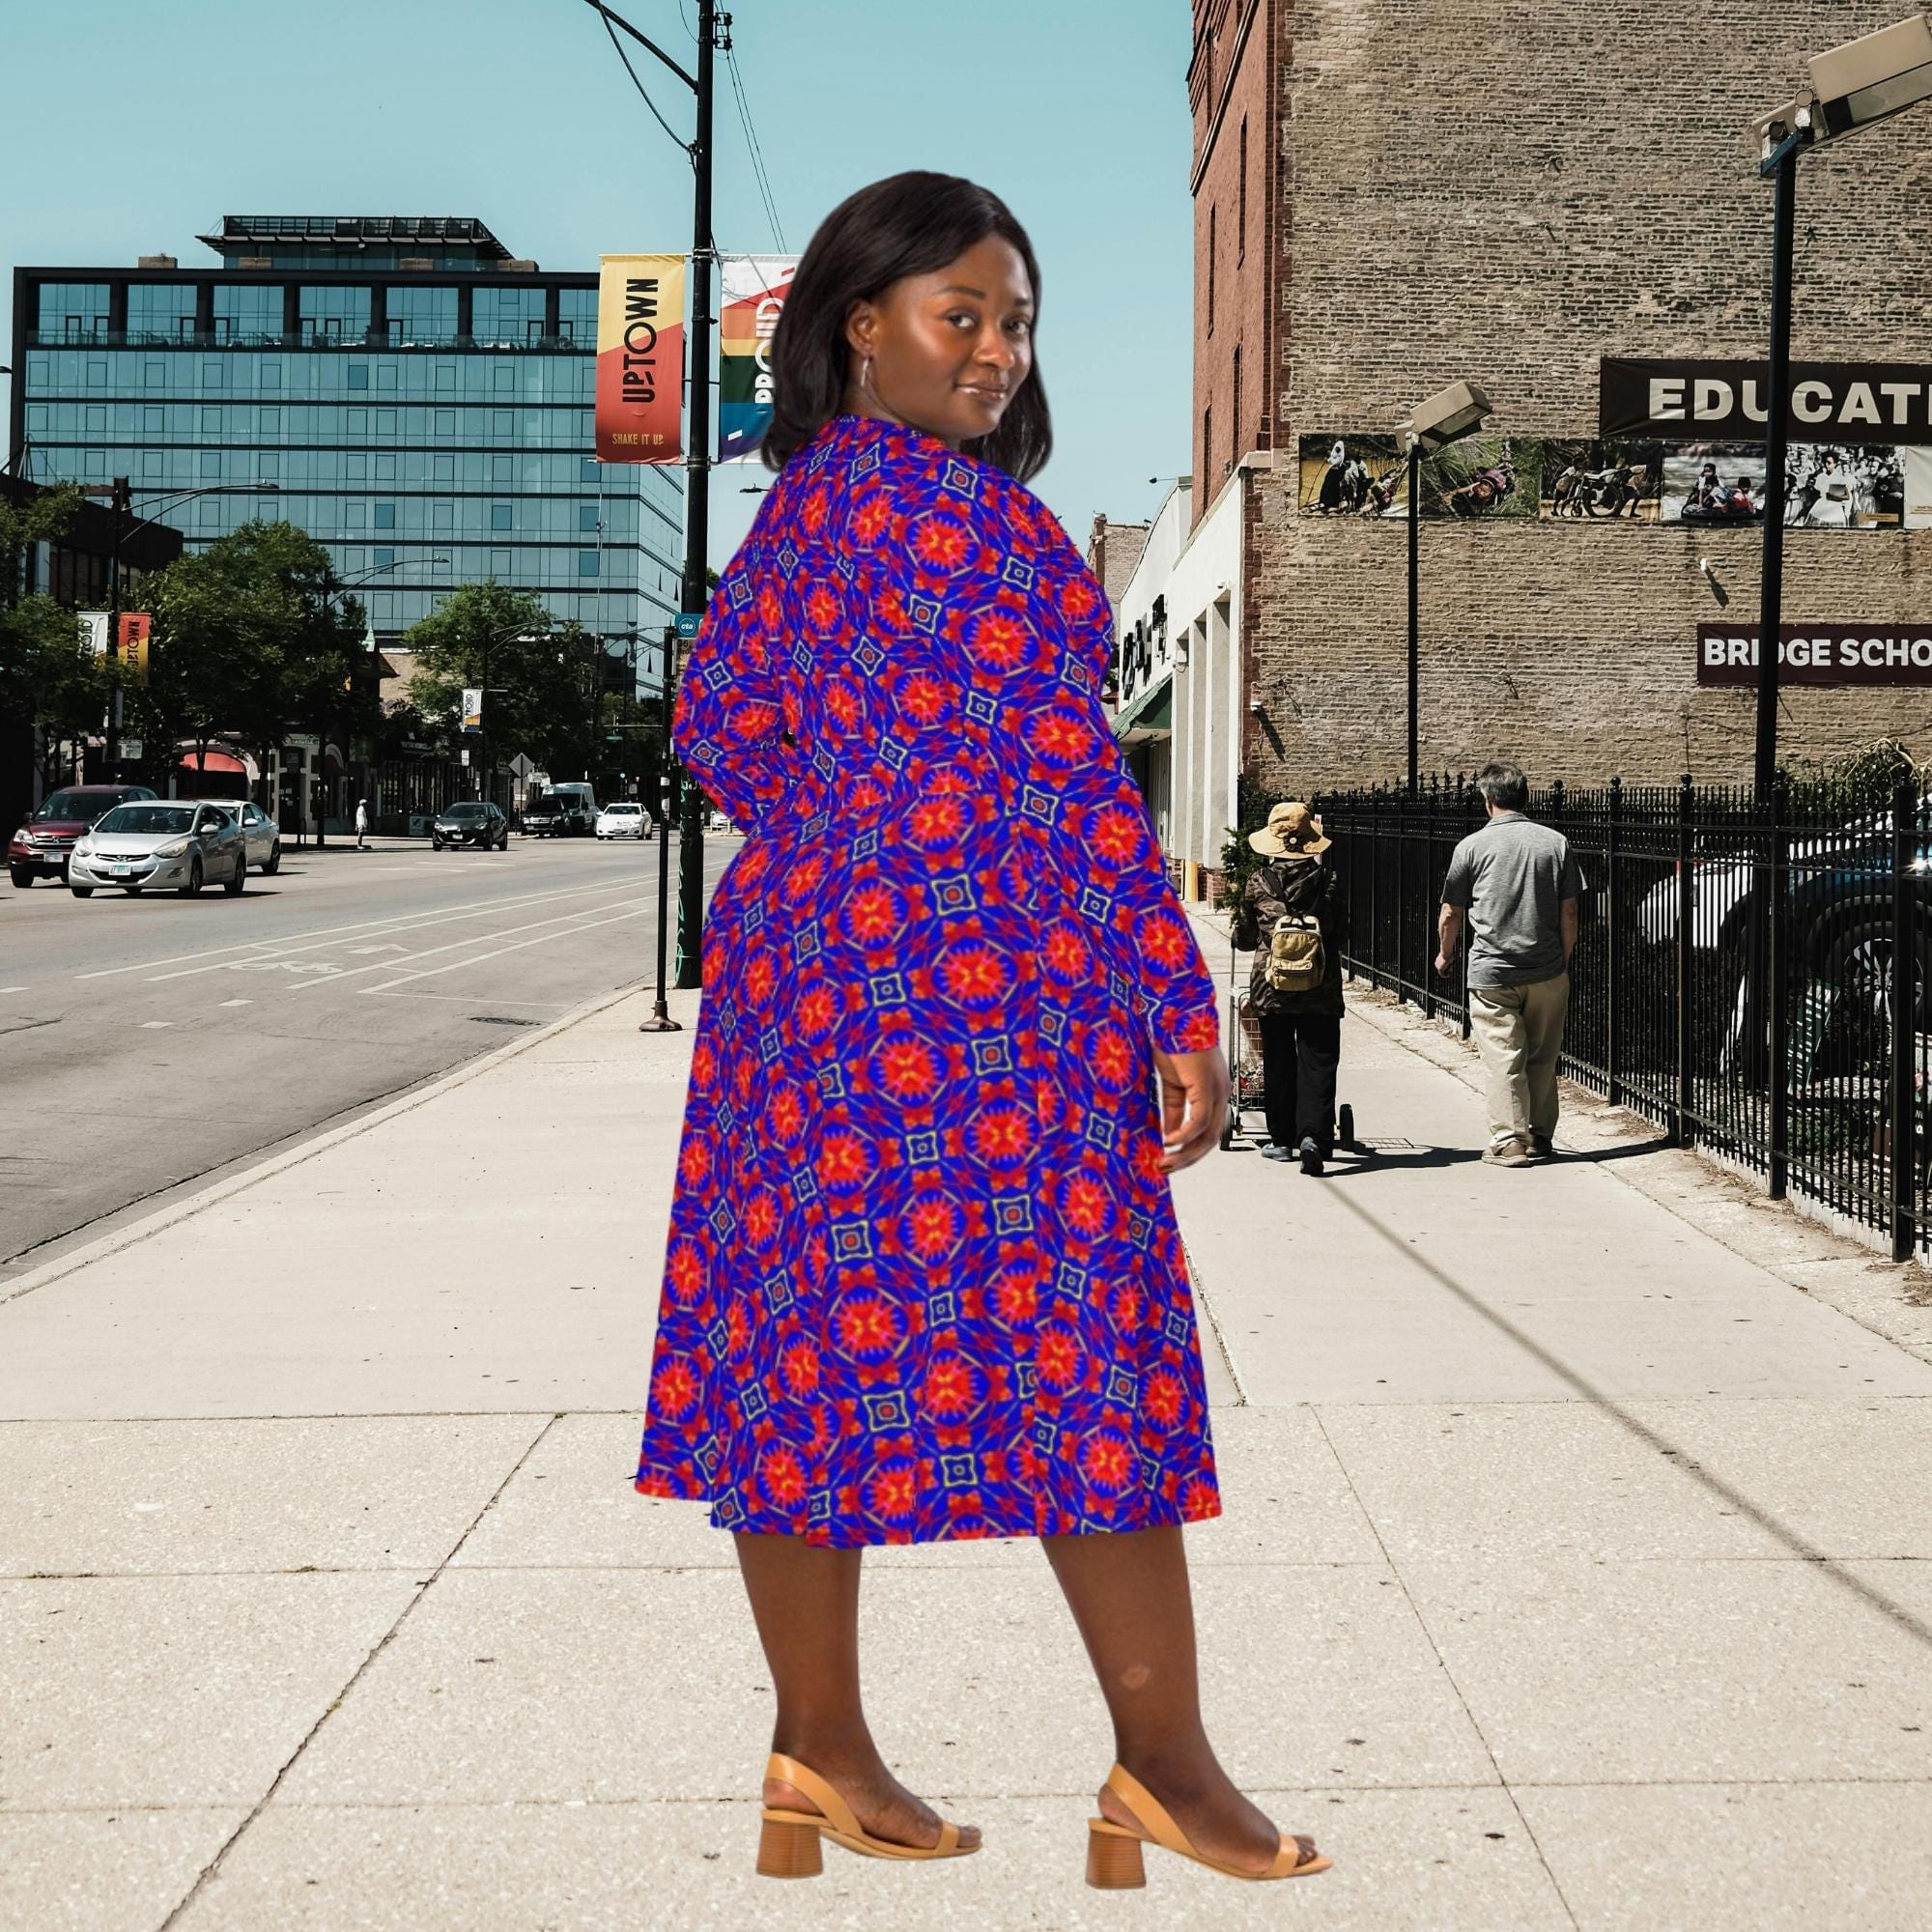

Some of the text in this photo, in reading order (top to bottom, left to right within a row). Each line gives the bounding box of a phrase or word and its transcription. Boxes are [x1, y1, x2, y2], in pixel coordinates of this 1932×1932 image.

[622, 278, 659, 403] UPTOWN
[1649, 378, 1932, 425] EDUCAT
[611, 433, 665, 445] SHAKE IT UP
[1704, 638, 1832, 667] BRIGE
